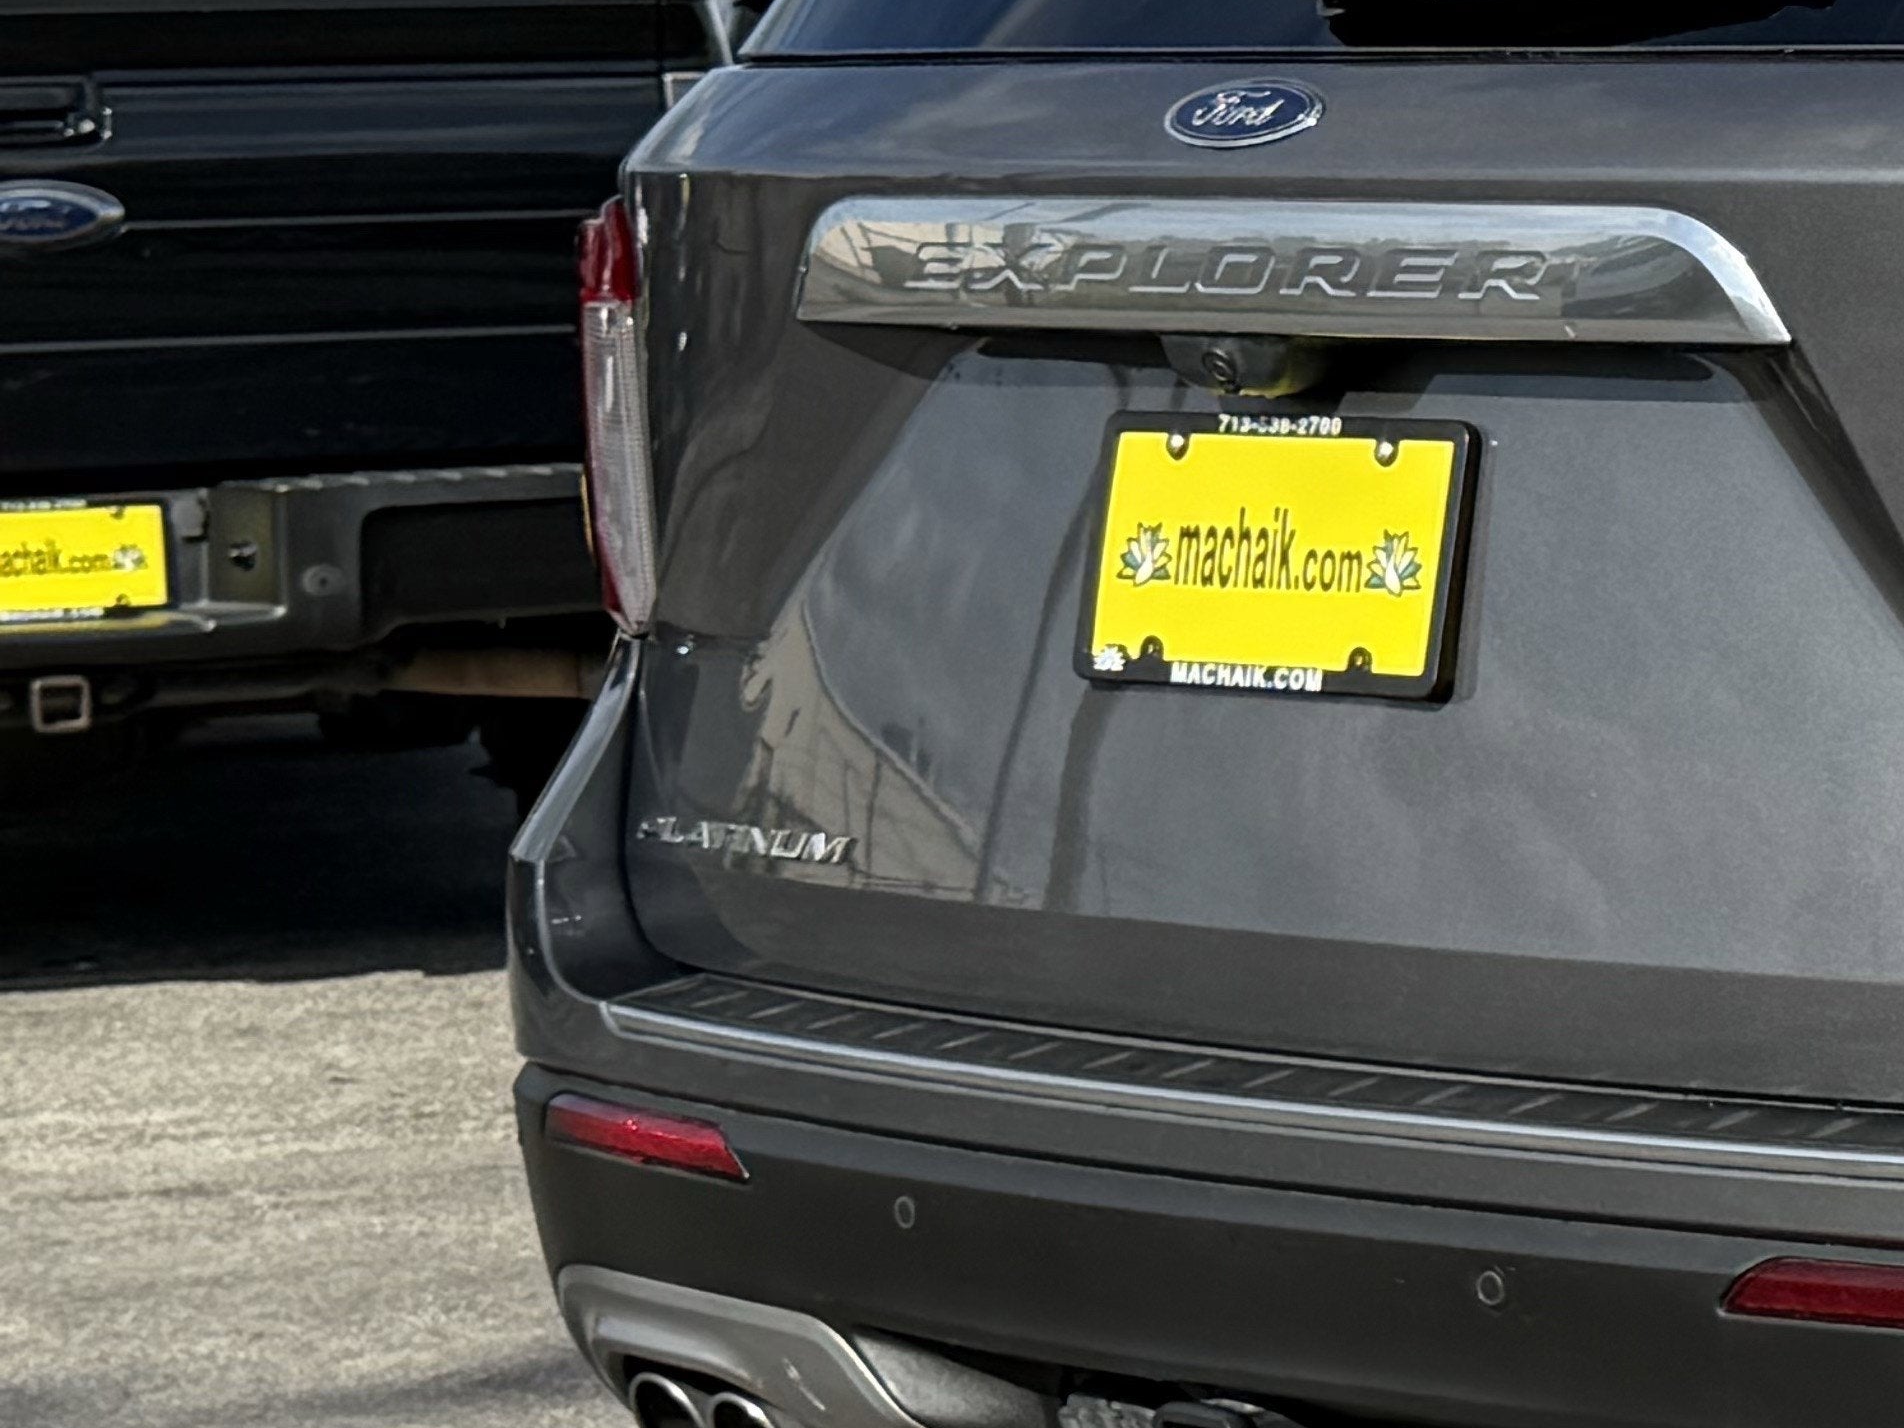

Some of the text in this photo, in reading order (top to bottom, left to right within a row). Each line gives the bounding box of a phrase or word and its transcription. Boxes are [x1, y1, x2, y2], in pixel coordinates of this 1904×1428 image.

[1192, 90, 1285, 126] Ford
[904, 241, 1548, 300] EXPLORER
[1174, 506, 1363, 593] machaik.com
[1170, 662, 1323, 692] MACHAIK.COM
